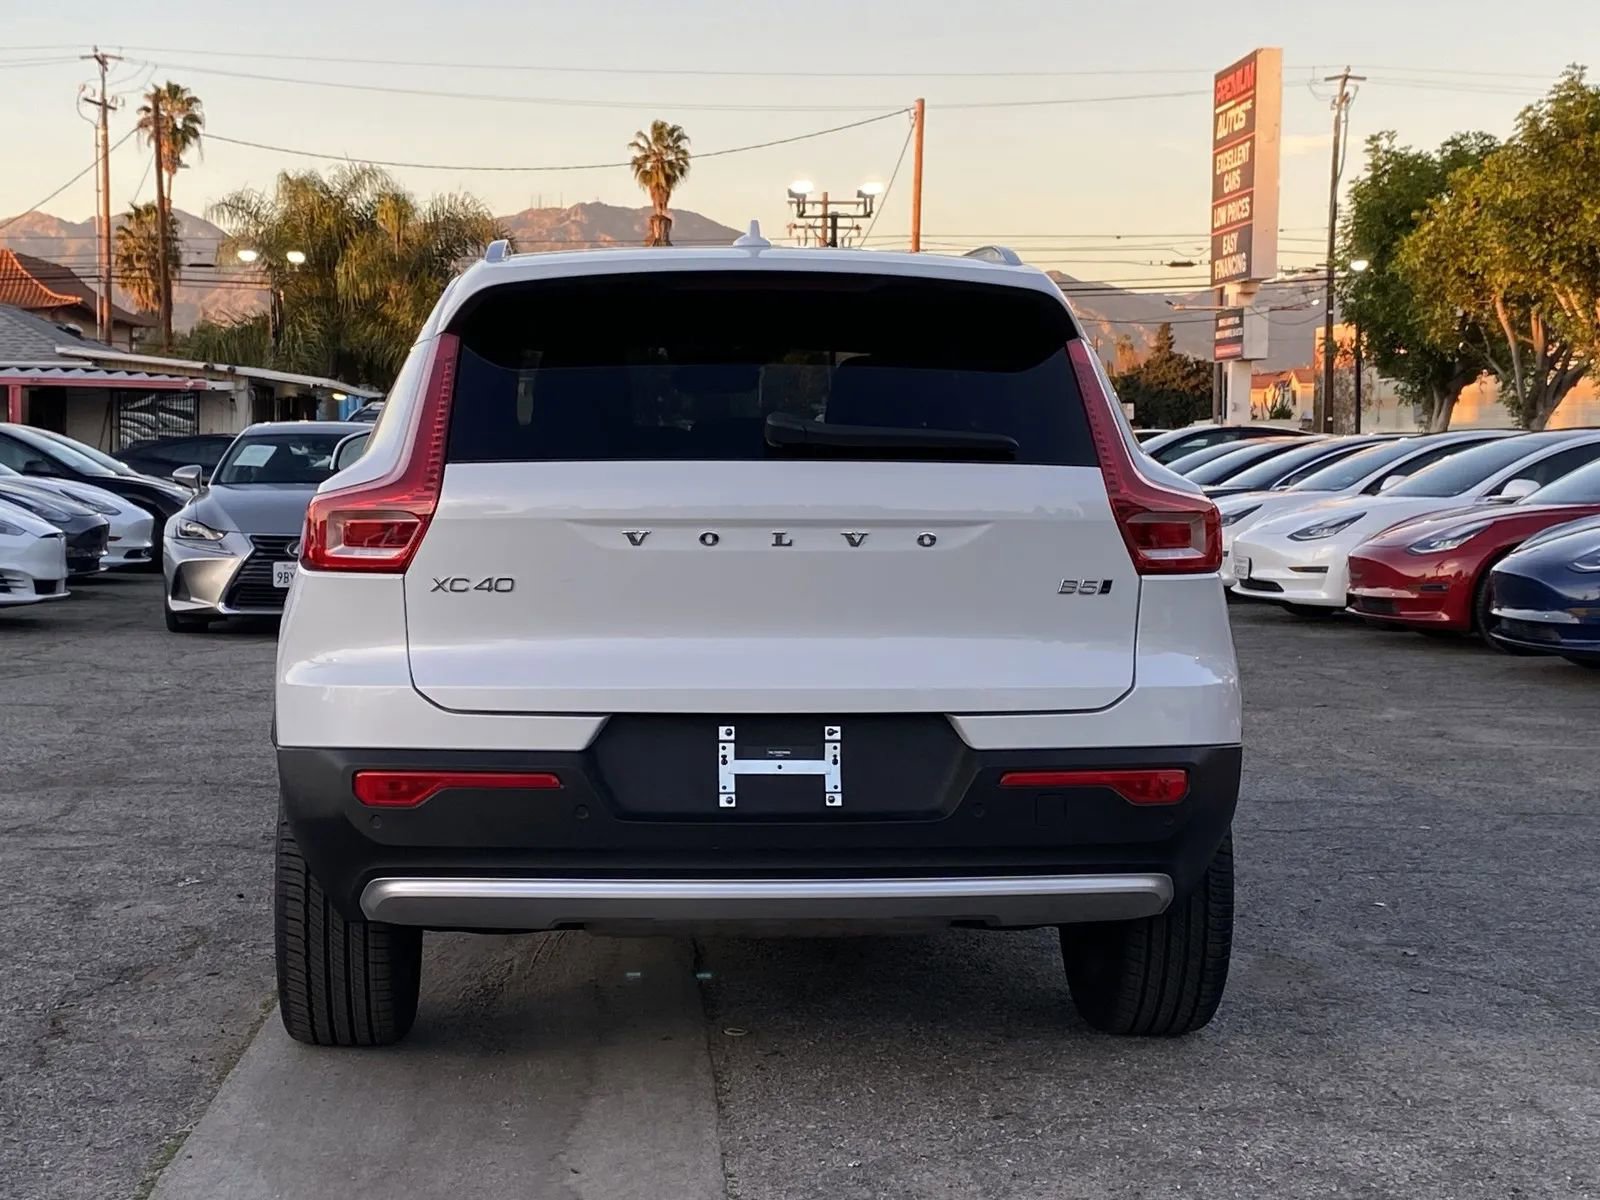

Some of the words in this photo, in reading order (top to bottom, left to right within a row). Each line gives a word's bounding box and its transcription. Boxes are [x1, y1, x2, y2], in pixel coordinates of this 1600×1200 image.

[1216, 107, 1246, 140] AUTOS
[1223, 169, 1241, 194] CARS
[1213, 203, 1227, 228] LOW
[1227, 196, 1250, 224] PRICES
[1222, 231, 1239, 256] EASY
[1214, 252, 1247, 280] FINANCING
[621, 530, 937, 548] VOLVO
